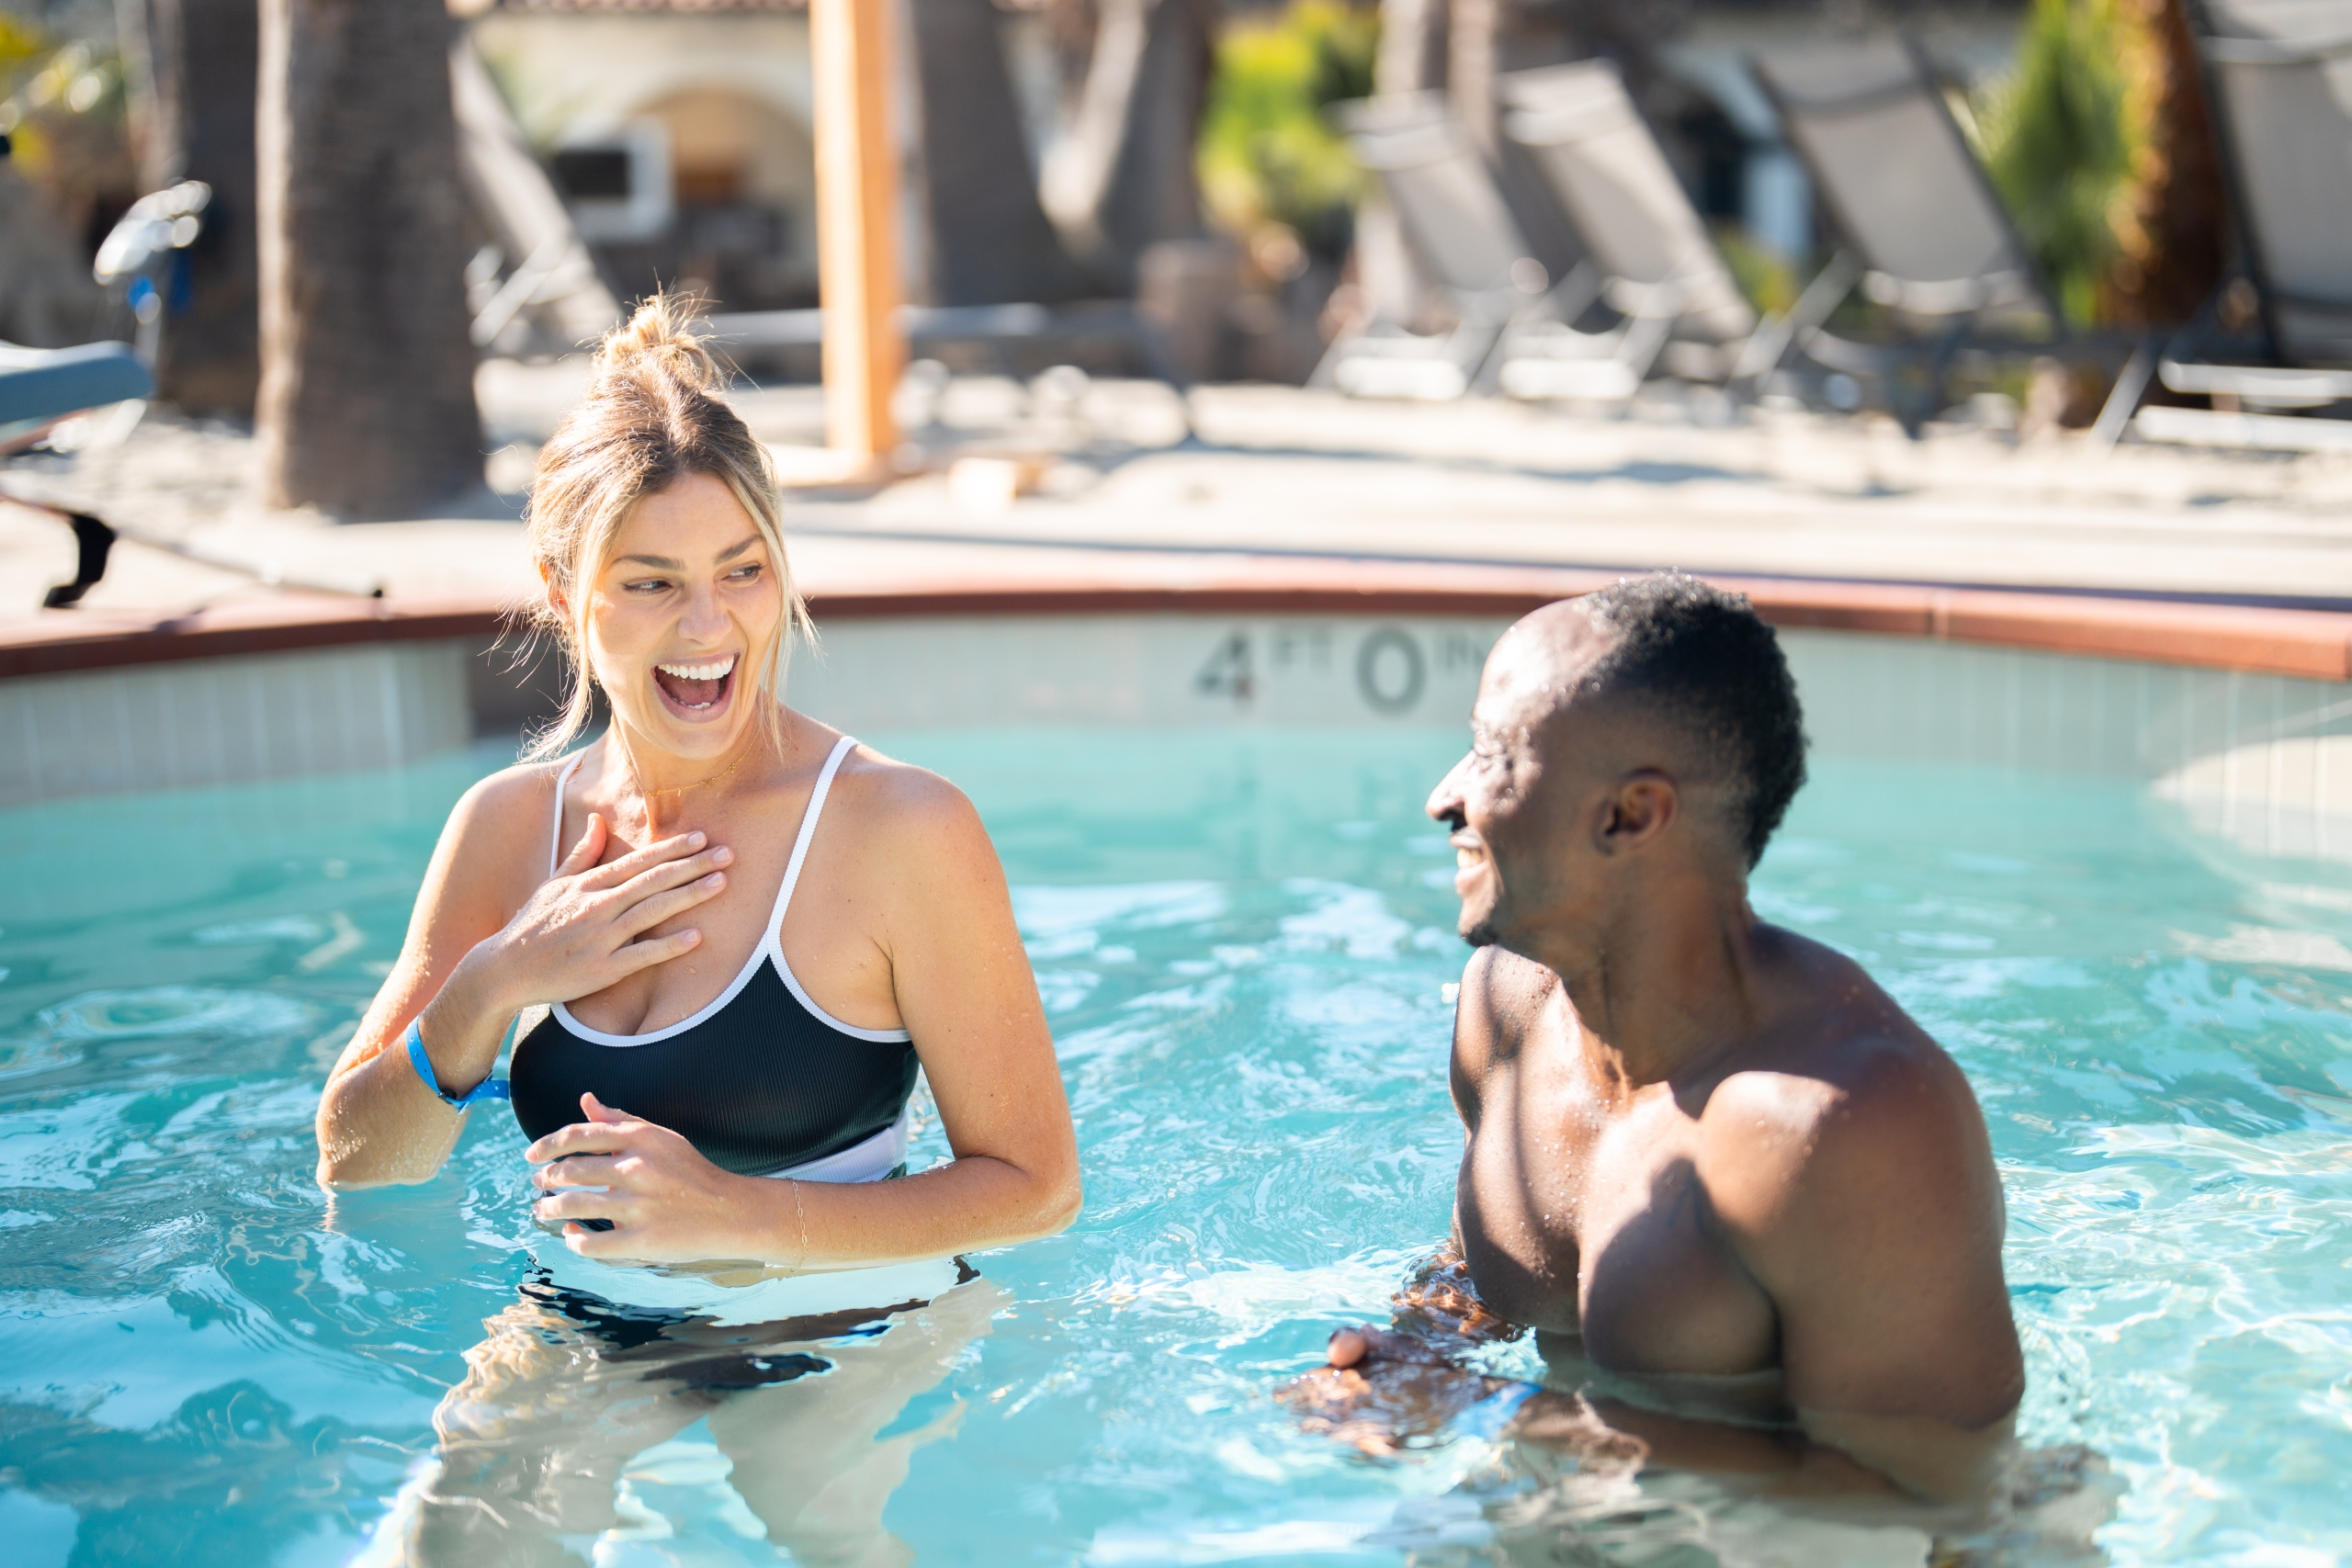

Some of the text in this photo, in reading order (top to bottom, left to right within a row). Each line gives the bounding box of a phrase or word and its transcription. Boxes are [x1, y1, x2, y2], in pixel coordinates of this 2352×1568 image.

[1194, 628, 1255, 707] 4
[1271, 628, 1333, 671] FT
[1355, 627, 1427, 716] 0
